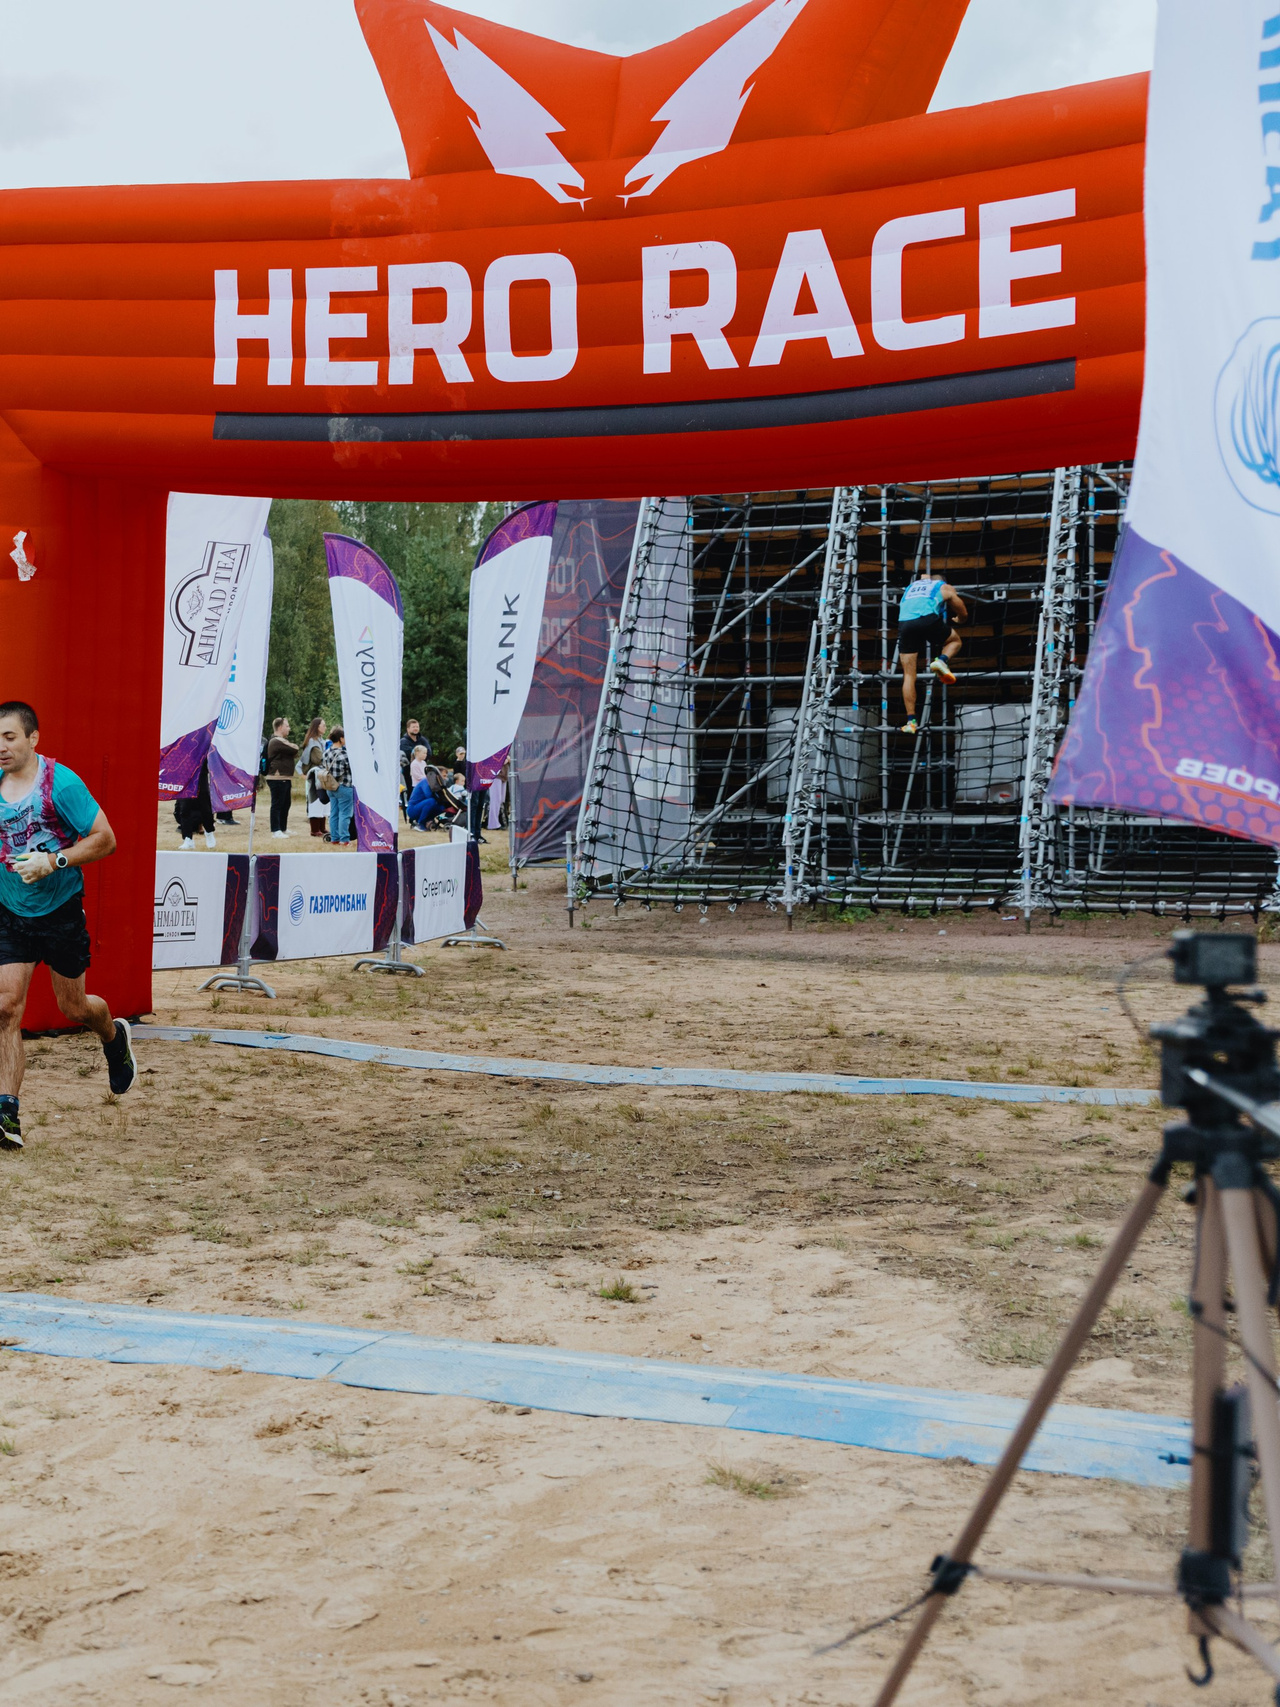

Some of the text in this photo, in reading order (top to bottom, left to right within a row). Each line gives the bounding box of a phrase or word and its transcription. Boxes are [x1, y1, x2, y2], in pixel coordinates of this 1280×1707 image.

[213, 188, 1077, 386] HERO RACE
[197, 548, 238, 664] AHMAD TEA
[493, 593, 520, 704] TANK
[158, 782, 184, 792] ЕРОЕВ
[422, 878, 455, 898] Greenway
[309, 893, 367, 914] ГАЗПРОМБАНК
[181, 910, 195, 926] TEA
